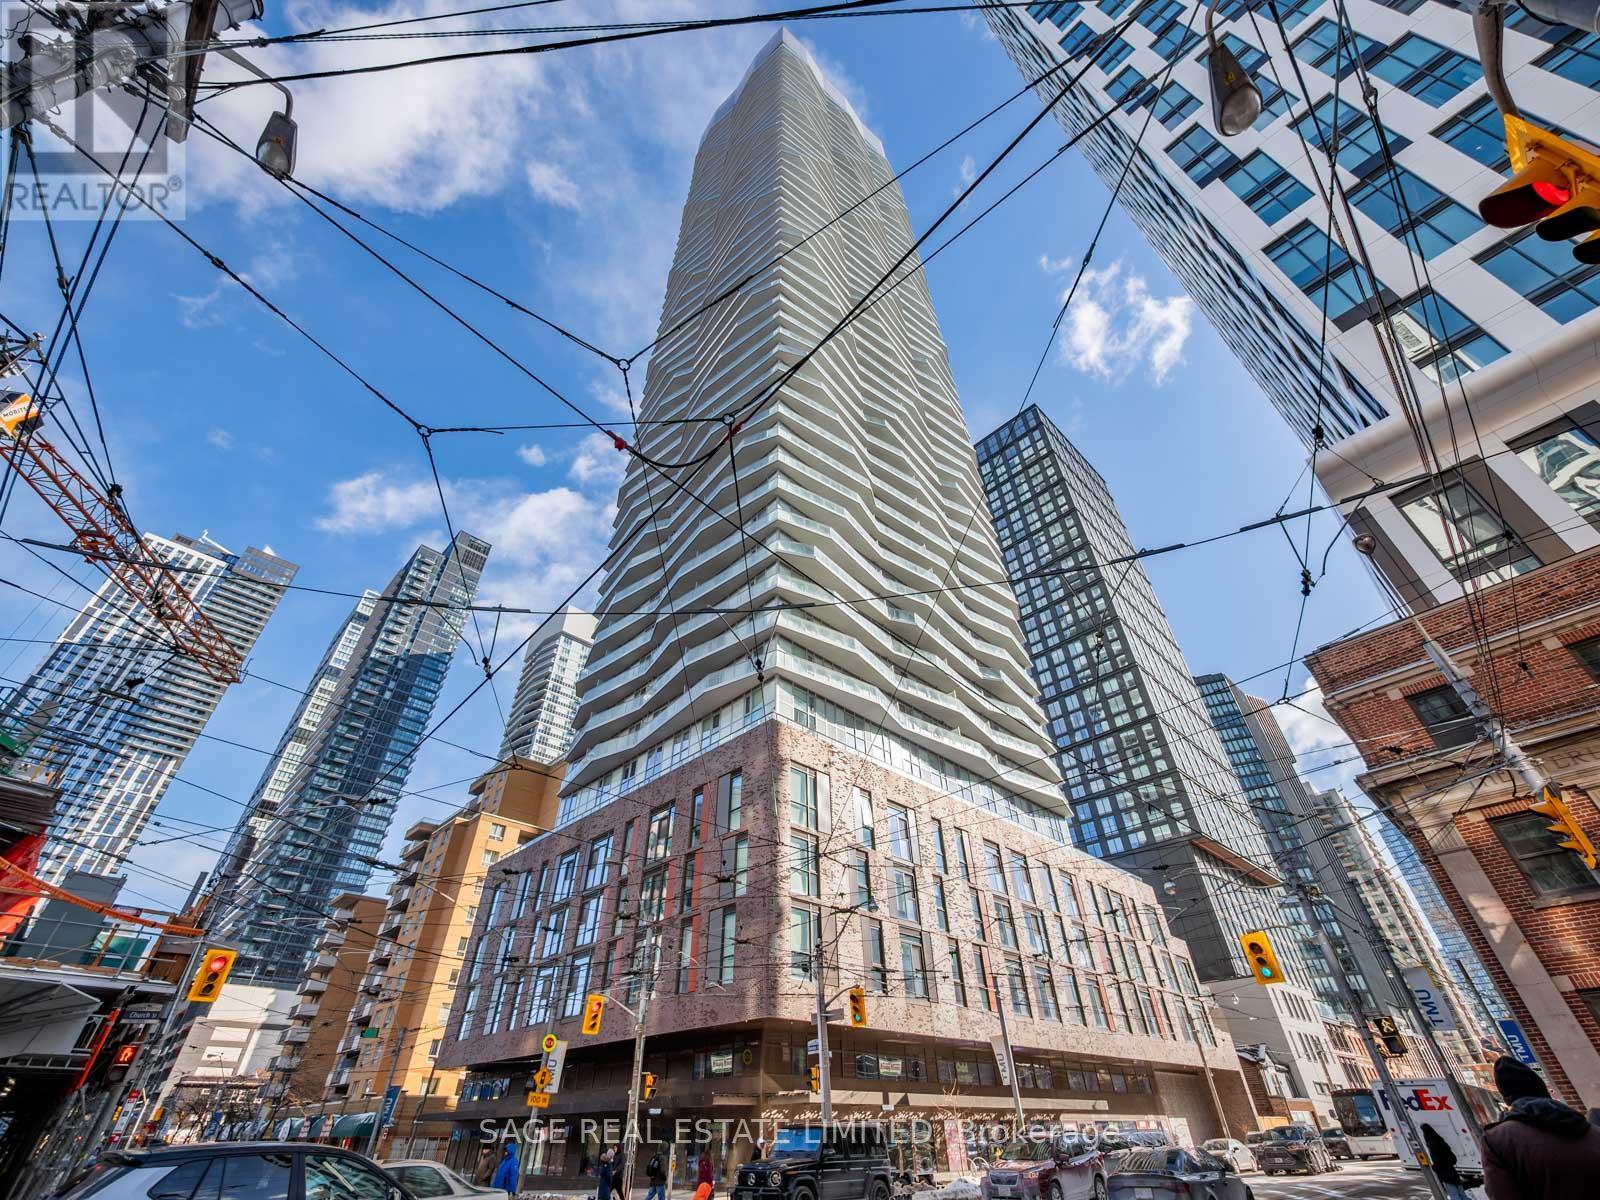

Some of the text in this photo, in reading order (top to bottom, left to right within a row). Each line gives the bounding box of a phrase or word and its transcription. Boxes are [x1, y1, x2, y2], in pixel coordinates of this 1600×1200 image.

[1414, 989, 1444, 1027] TMU
[1507, 1034, 1529, 1062] TMU
[996, 1053, 1008, 1081] TMU
